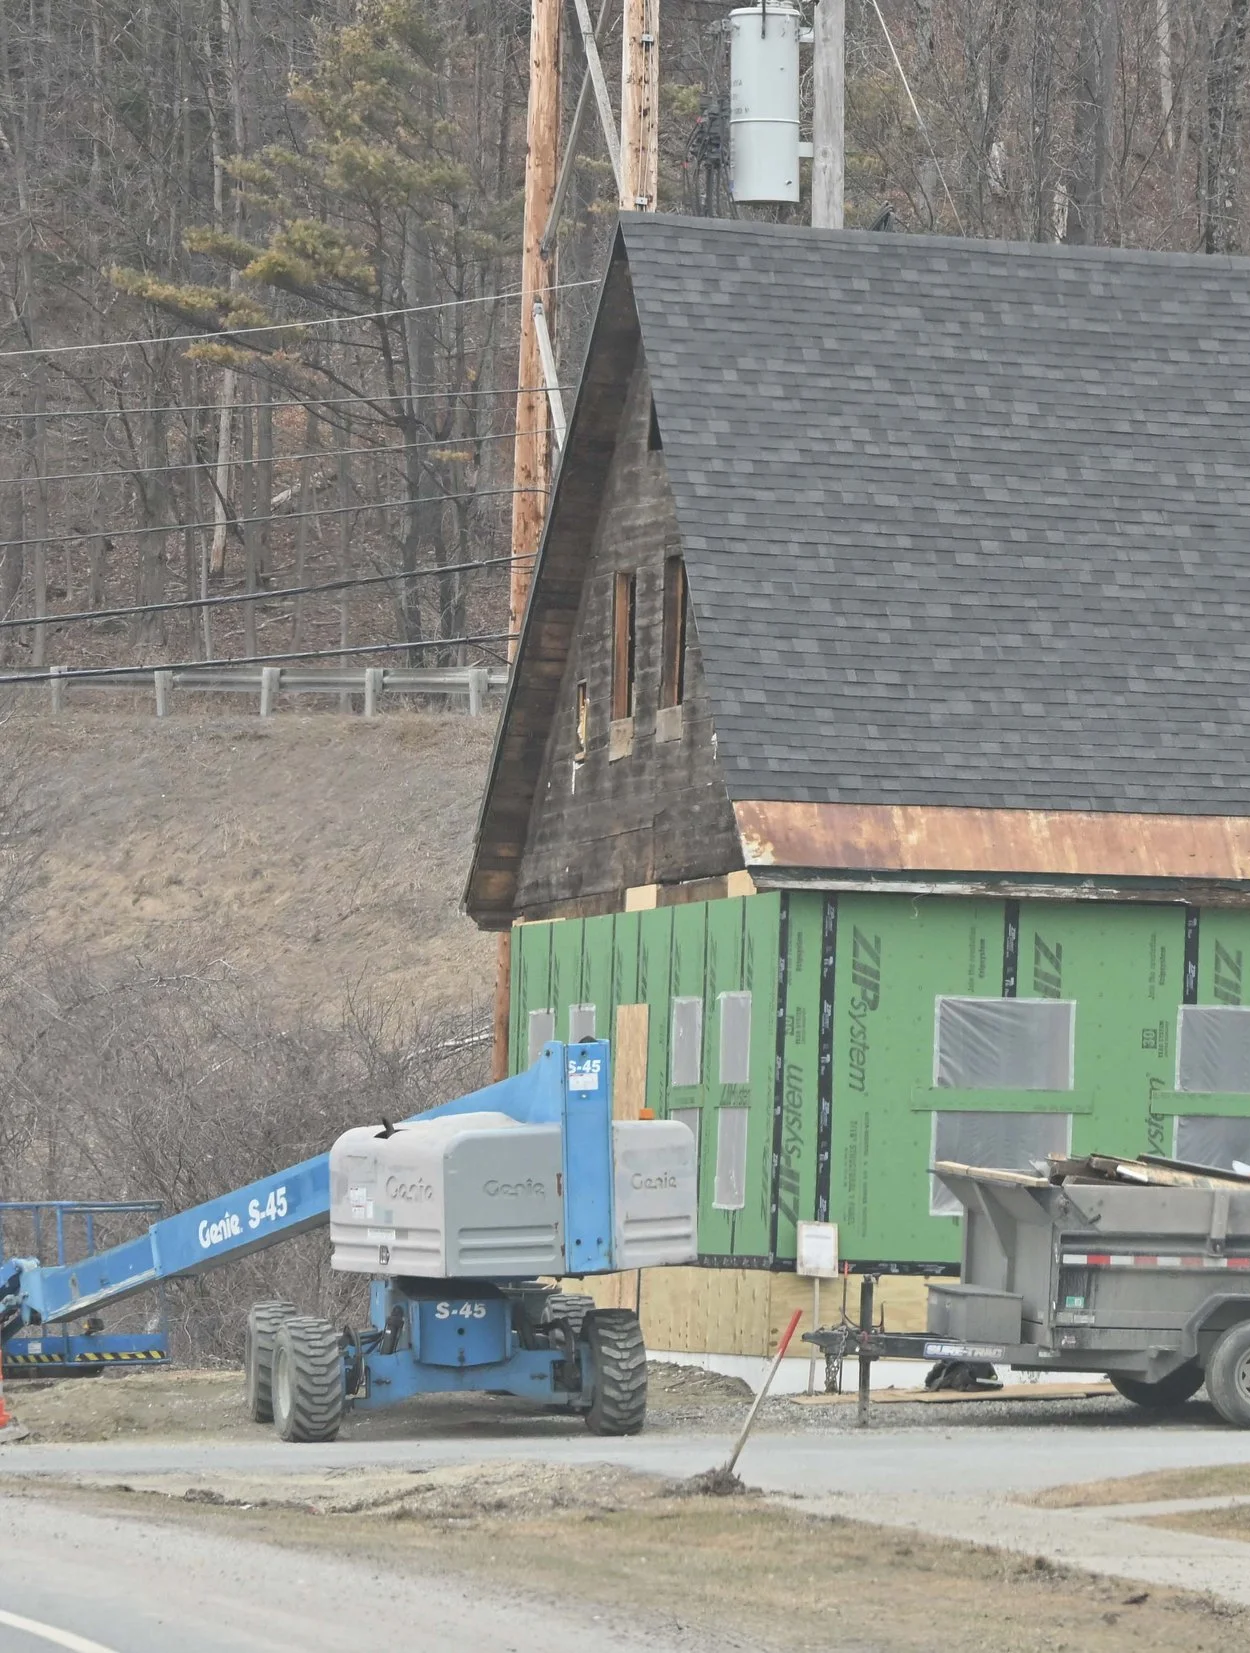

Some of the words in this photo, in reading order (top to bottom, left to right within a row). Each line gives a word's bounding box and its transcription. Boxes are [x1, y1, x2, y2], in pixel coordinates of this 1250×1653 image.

[568, 1059, 601, 1074] S-45
[385, 1175, 433, 1201] Genie
[483, 1178, 545, 1198] Genie
[630, 1171, 677, 1190] Genie
[198, 1211, 241, 1249] Genie
[248, 1186, 288, 1229] S-45
[434, 1301, 487, 1319] S-45
